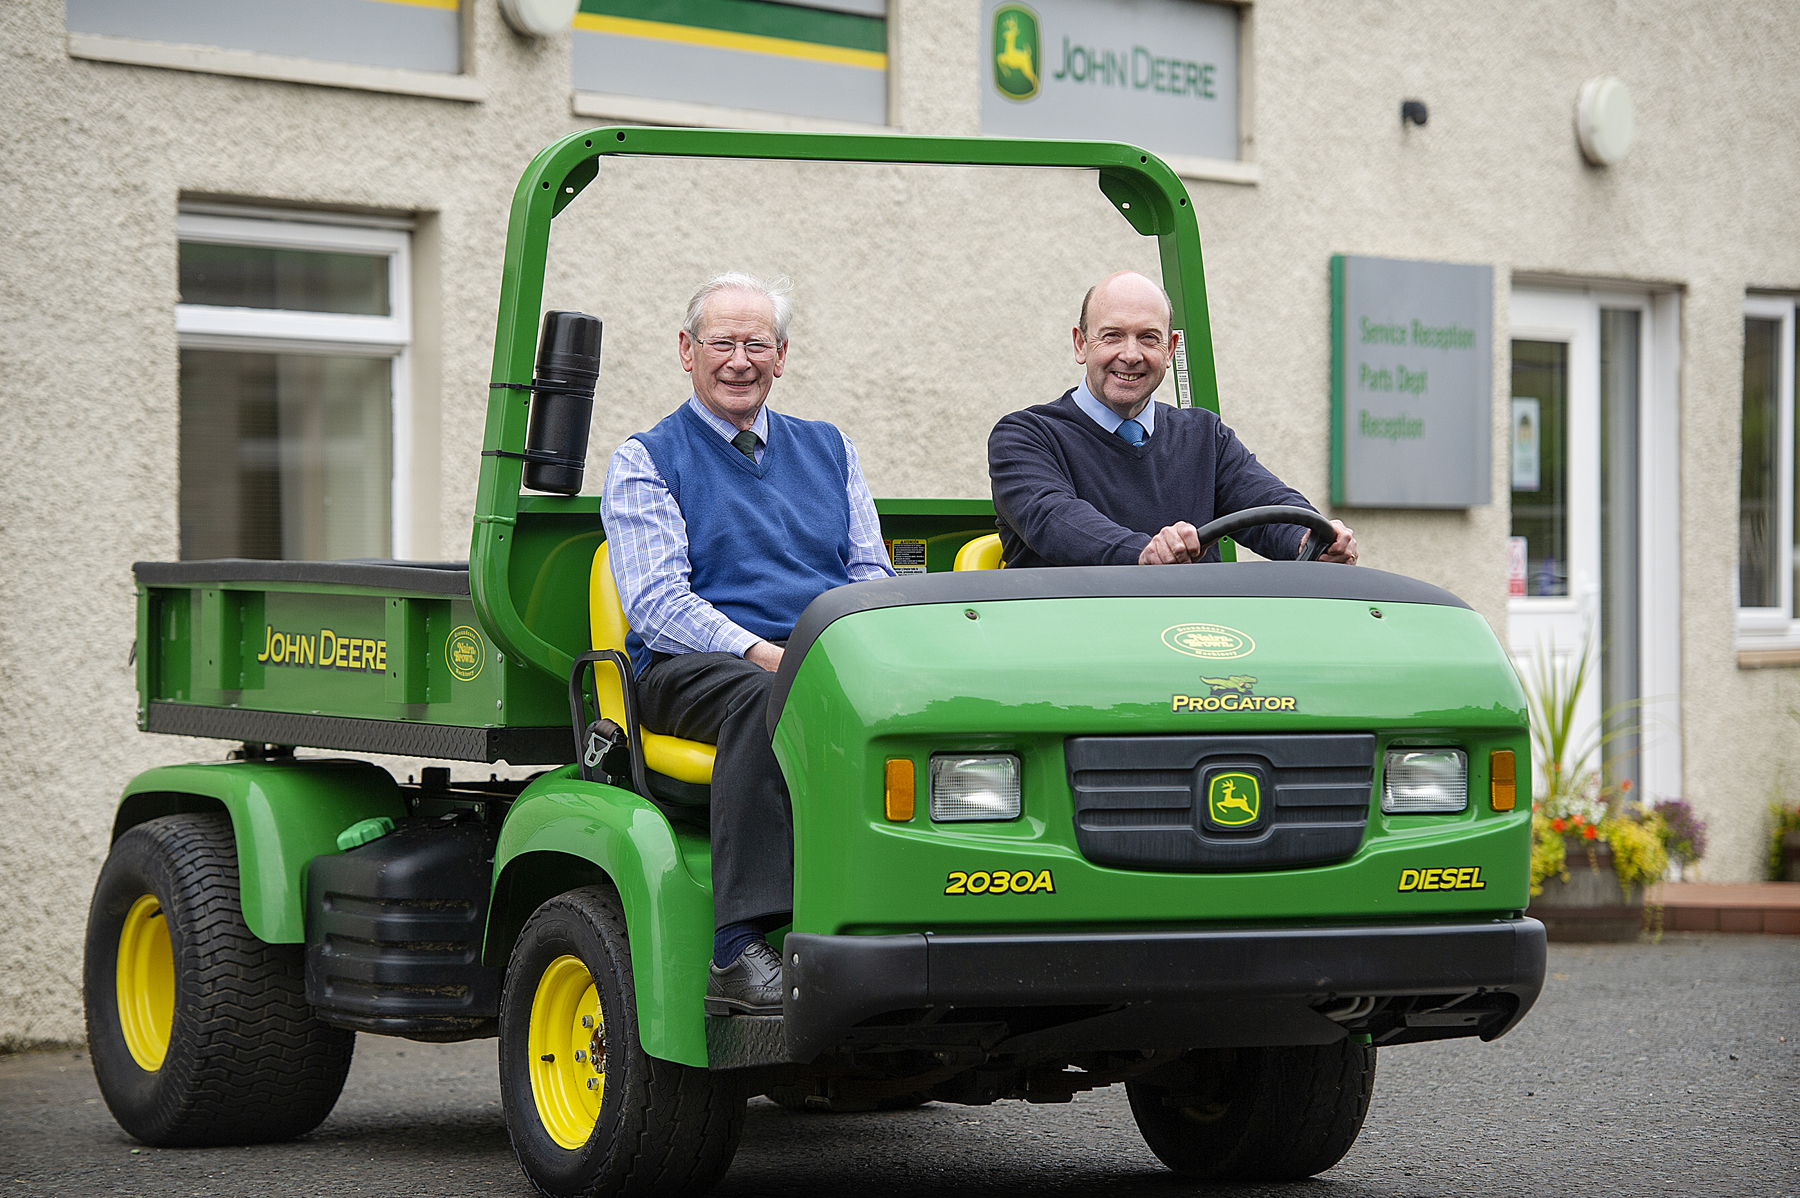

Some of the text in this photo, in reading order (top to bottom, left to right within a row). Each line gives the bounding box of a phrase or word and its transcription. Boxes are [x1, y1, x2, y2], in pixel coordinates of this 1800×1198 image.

[1053, 35, 1217, 99] JOHN DEERE
[1359, 314, 1476, 353] Service Reception
[1359, 361, 1429, 398] Parts Dept
[1359, 409, 1425, 445] Reception
[257, 625, 386, 671] JOHN DEERE
[944, 869, 1055, 895] 2030A
[1398, 866, 1486, 892] DIESEL
